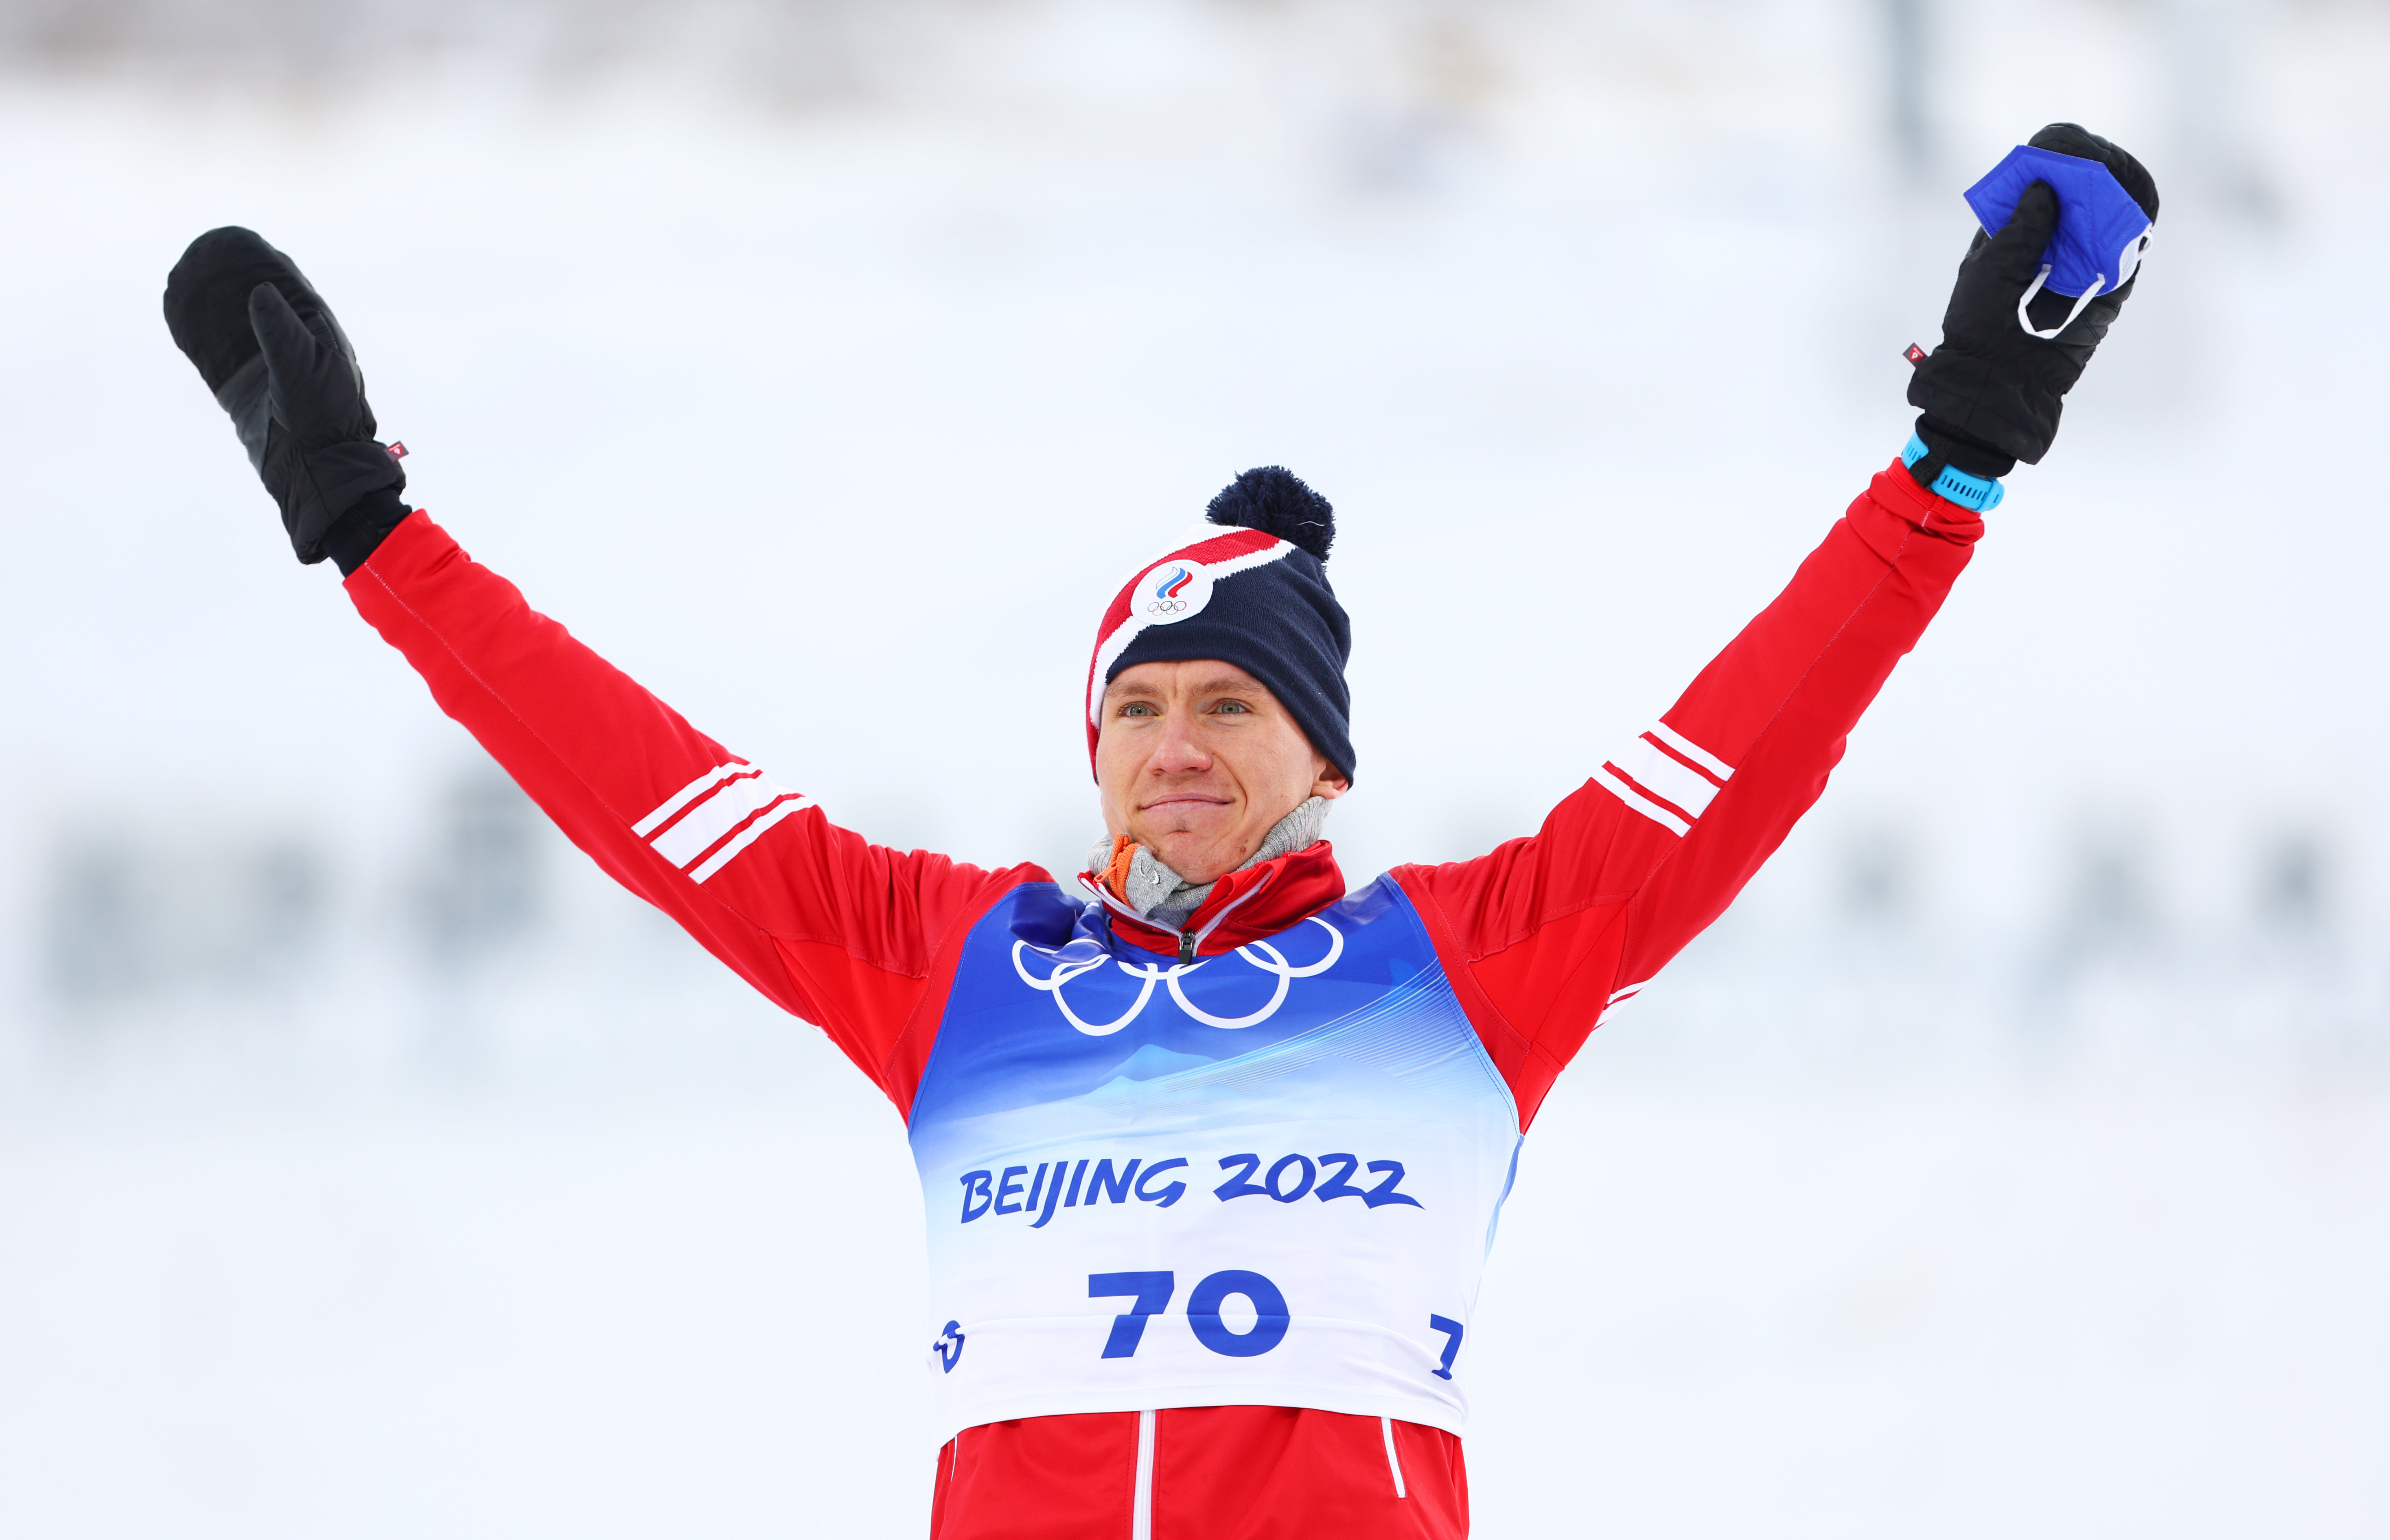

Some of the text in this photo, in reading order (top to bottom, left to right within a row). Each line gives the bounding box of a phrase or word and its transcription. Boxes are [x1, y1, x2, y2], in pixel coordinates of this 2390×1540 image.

[959, 1153, 1426, 1229] BEIJING 2022
[1088, 1269, 1291, 1359] 70
